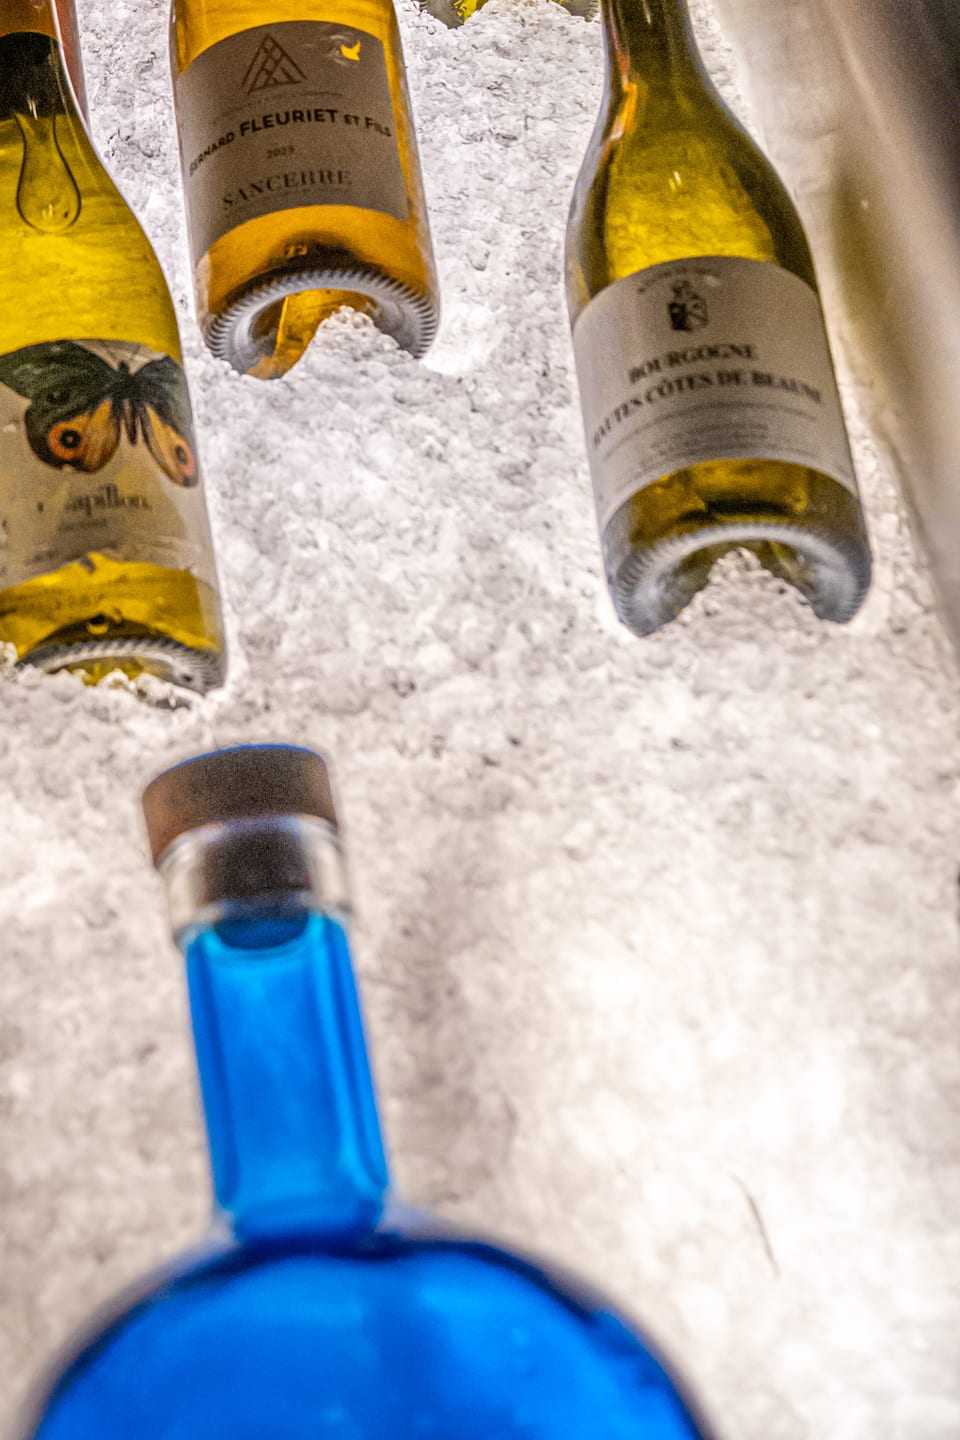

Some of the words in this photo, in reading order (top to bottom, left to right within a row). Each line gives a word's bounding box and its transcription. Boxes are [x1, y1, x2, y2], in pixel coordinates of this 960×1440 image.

[240, 108, 339, 137] FLEURIET
[343, 114, 361, 127] ET
[222, 169, 353, 207] SANCERRE
[628, 343, 756, 384] BOURGOGNE
[715, 369, 745, 386] DE
[38, 479, 155, 517] apillon
